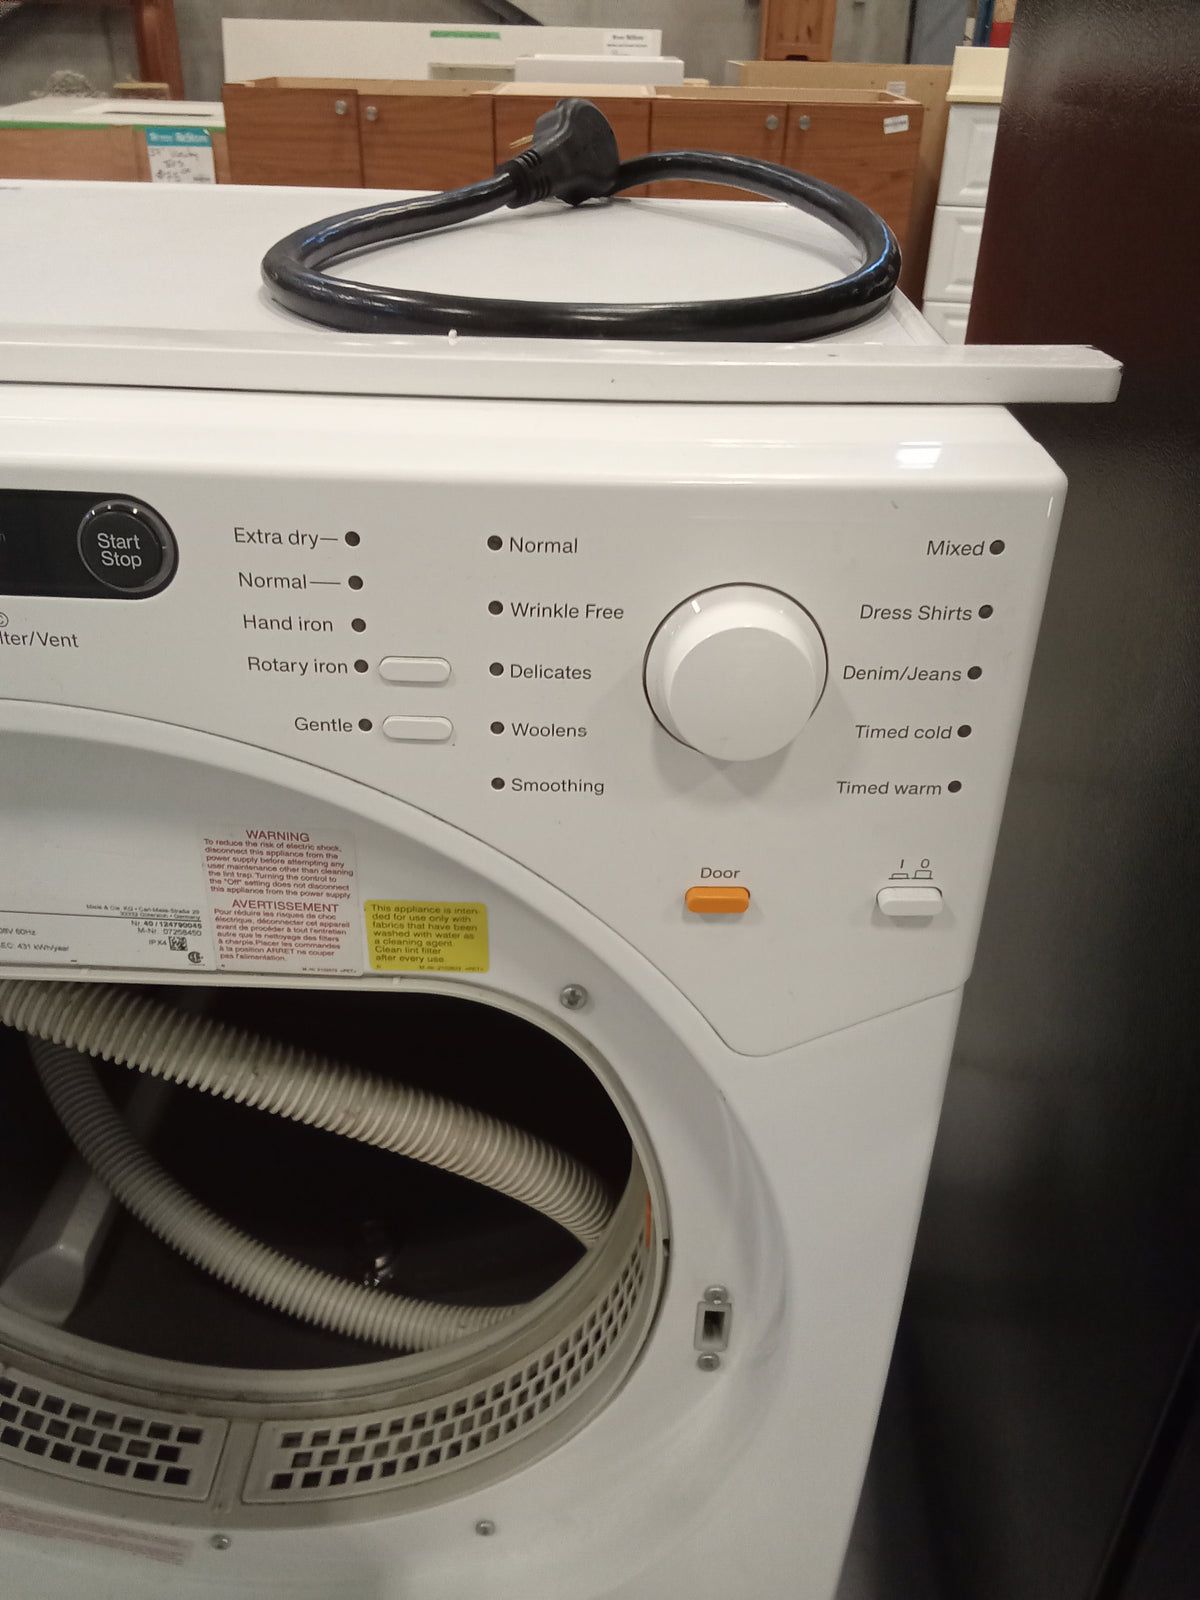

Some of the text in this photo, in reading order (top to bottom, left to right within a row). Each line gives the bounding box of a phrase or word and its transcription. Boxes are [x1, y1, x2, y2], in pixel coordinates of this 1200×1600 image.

[98, 533, 140, 549] Start
[234, 527, 318, 549] Extra dry
[510, 537, 577, 553] Normal
[927, 541, 985, 556] Mixed
[101, 551, 141, 569] Stop
[239, 572, 306, 589] Normal
[511, 603, 623, 619] Wrinkle Free
[860, 605, 972, 620] Dress Shirts
[244, 614, 332, 632] Hand iron
[248, 657, 347, 676] Rotary iron
[511, 664, 591, 679] Delicates
[844, 666, 961, 681] Denim/Jeans
[295, 717, 352, 732] Gentle
[512, 723, 587, 737] Woolens
[856, 725, 952, 739] Timed cold
[512, 778, 604, 795] Smoothing
[837, 781, 941, 795] Timed warm
[246, 830, 309, 842] WARNING
[266, 850, 303, 858] appliance
[288, 859, 328, 867] attempting
[321, 868, 353, 876] cleaning
[701, 868, 740, 878] Door
[308, 883, 349, 891] disconnect
[232, 899, 339, 912] AVERTISSEMENT
[372, 904, 391, 912] This
[394, 905, 440, 914] appliance
[251, 925, 284, 933] procéder
[383, 938, 423, 946] cleaning
